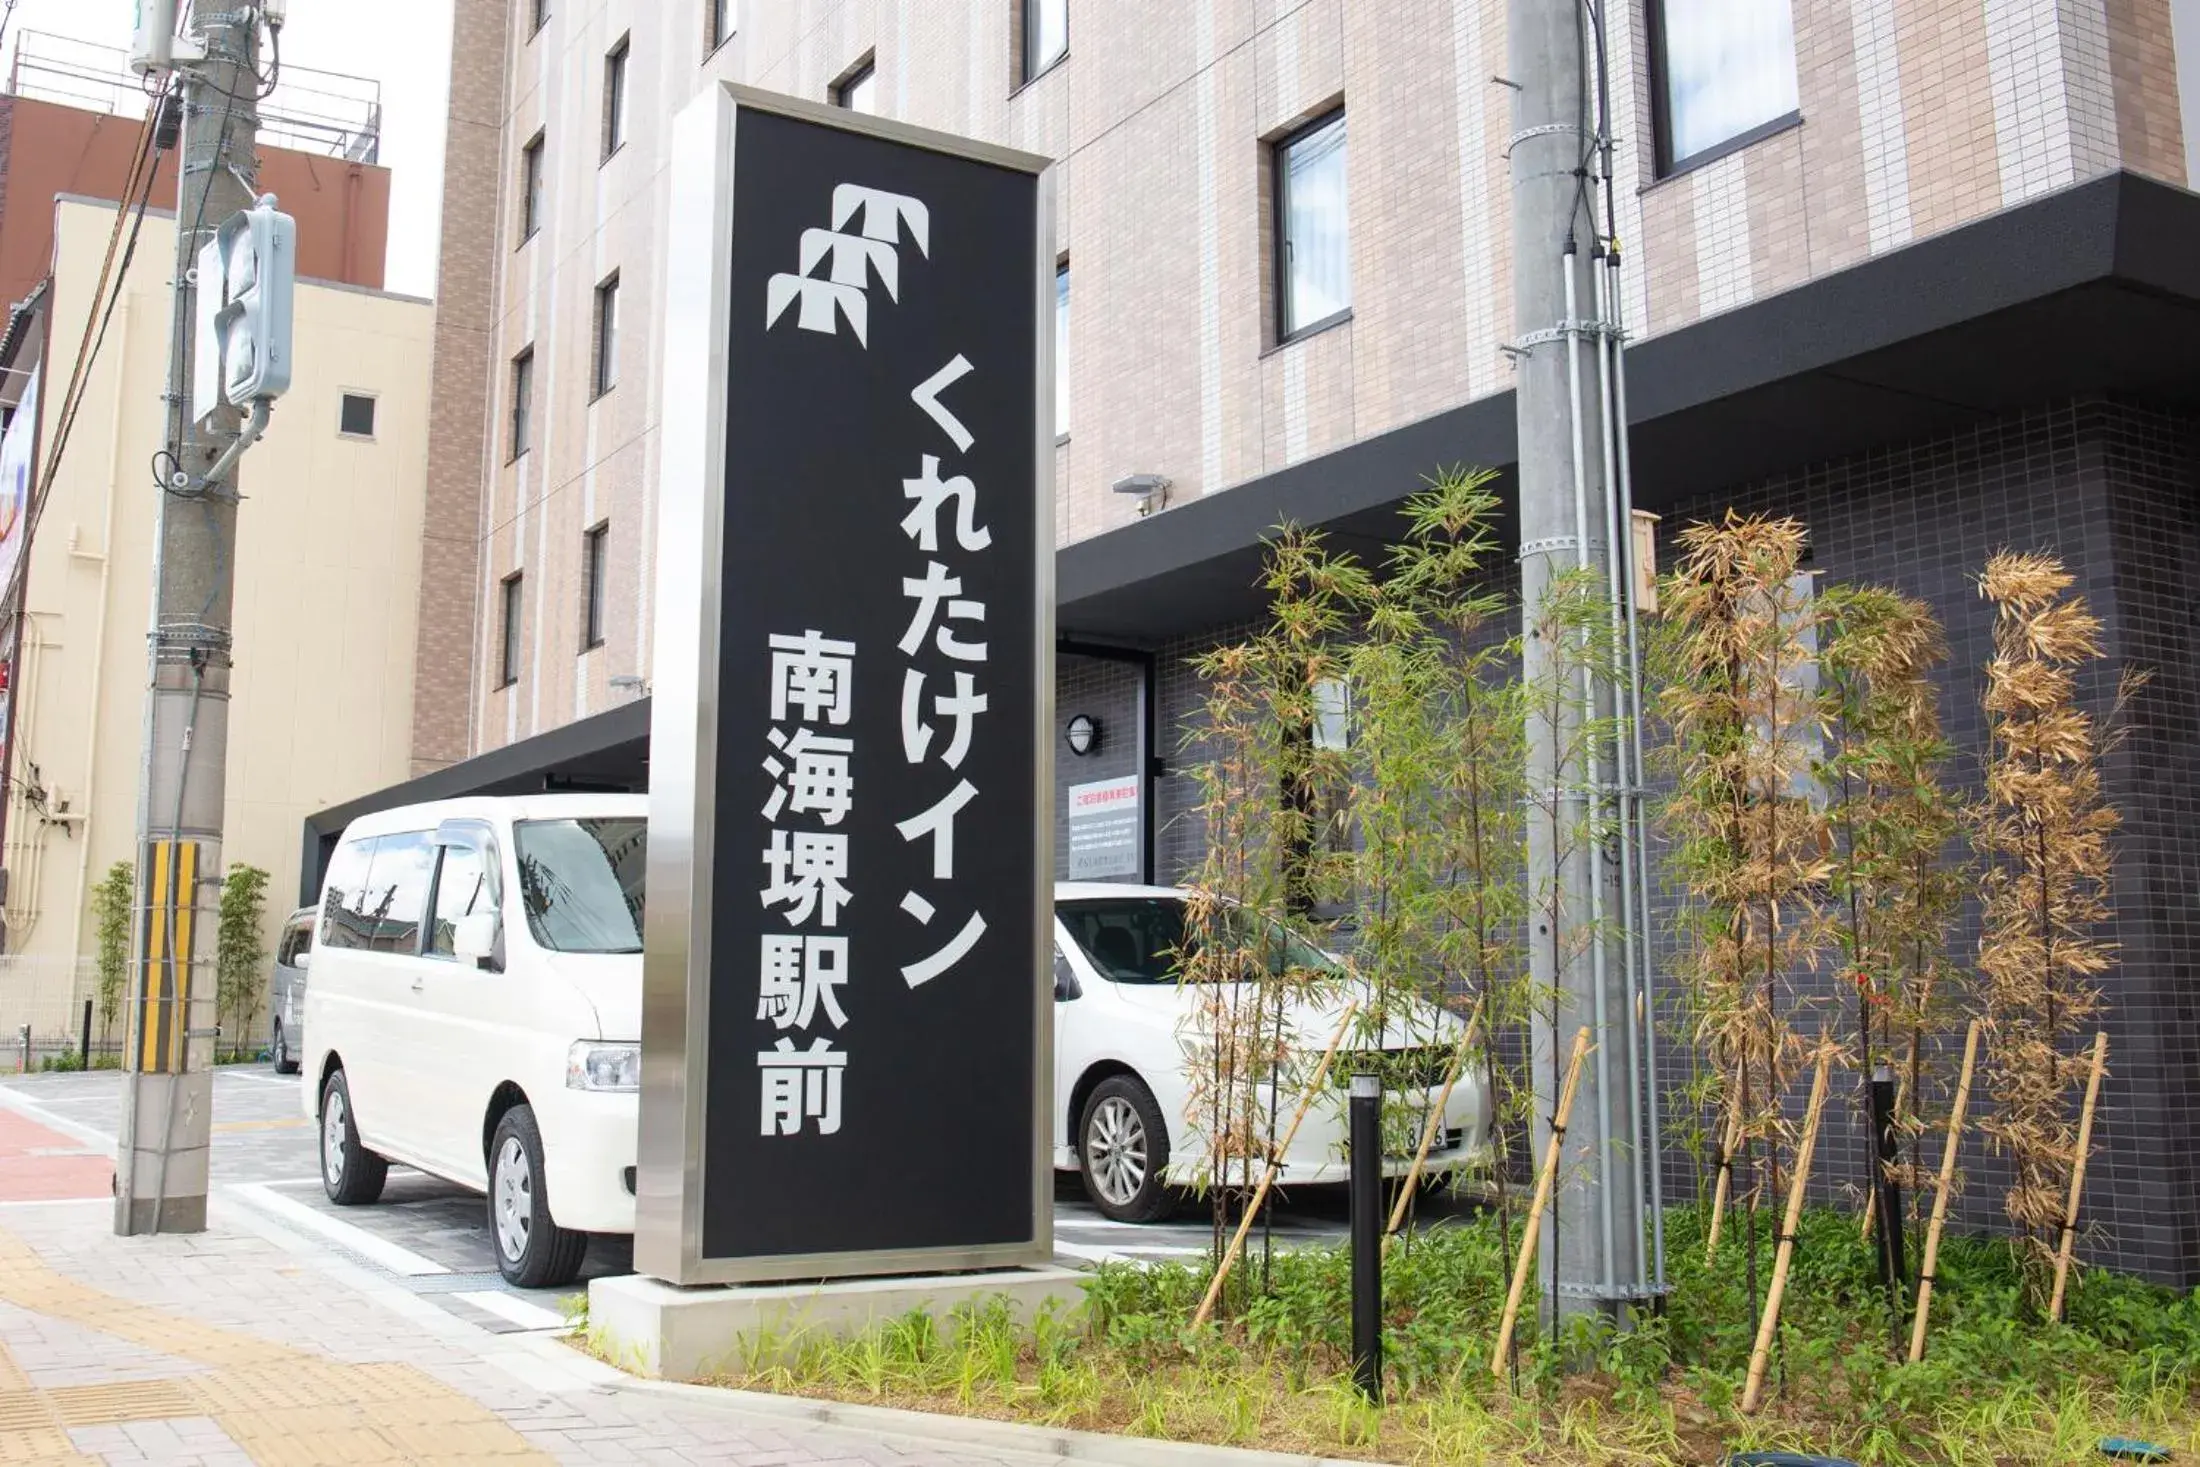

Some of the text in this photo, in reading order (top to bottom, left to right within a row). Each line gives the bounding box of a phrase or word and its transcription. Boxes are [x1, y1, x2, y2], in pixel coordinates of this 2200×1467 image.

[756, 630, 856, 1135] 南海堺駅前
[895, 353, 992, 989] くれたけイン
